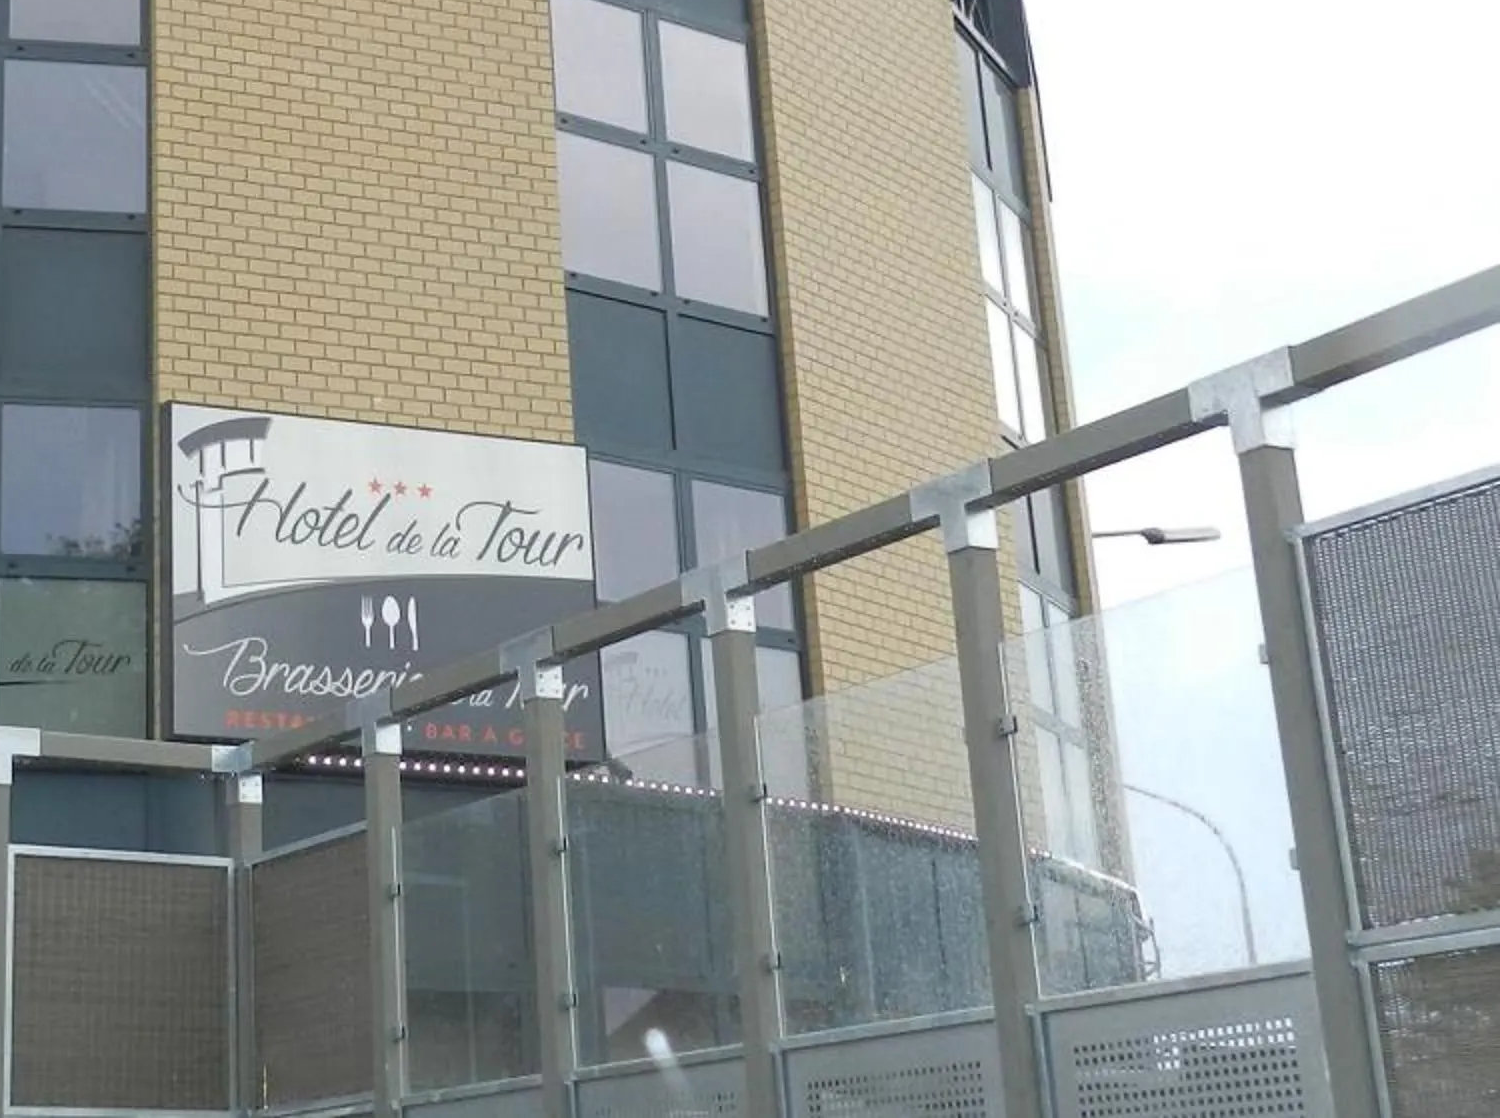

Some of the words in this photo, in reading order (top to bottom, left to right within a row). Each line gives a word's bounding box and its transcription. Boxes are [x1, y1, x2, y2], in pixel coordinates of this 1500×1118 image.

[178, 478, 376, 551] Hotel
[386, 520, 424, 556] de
[430, 521, 462, 560] la
[455, 499, 585, 568] Tour
[51, 638, 132, 676] Tour
[183, 636, 426, 700] Brasseri
[423, 720, 473, 744] BAR
